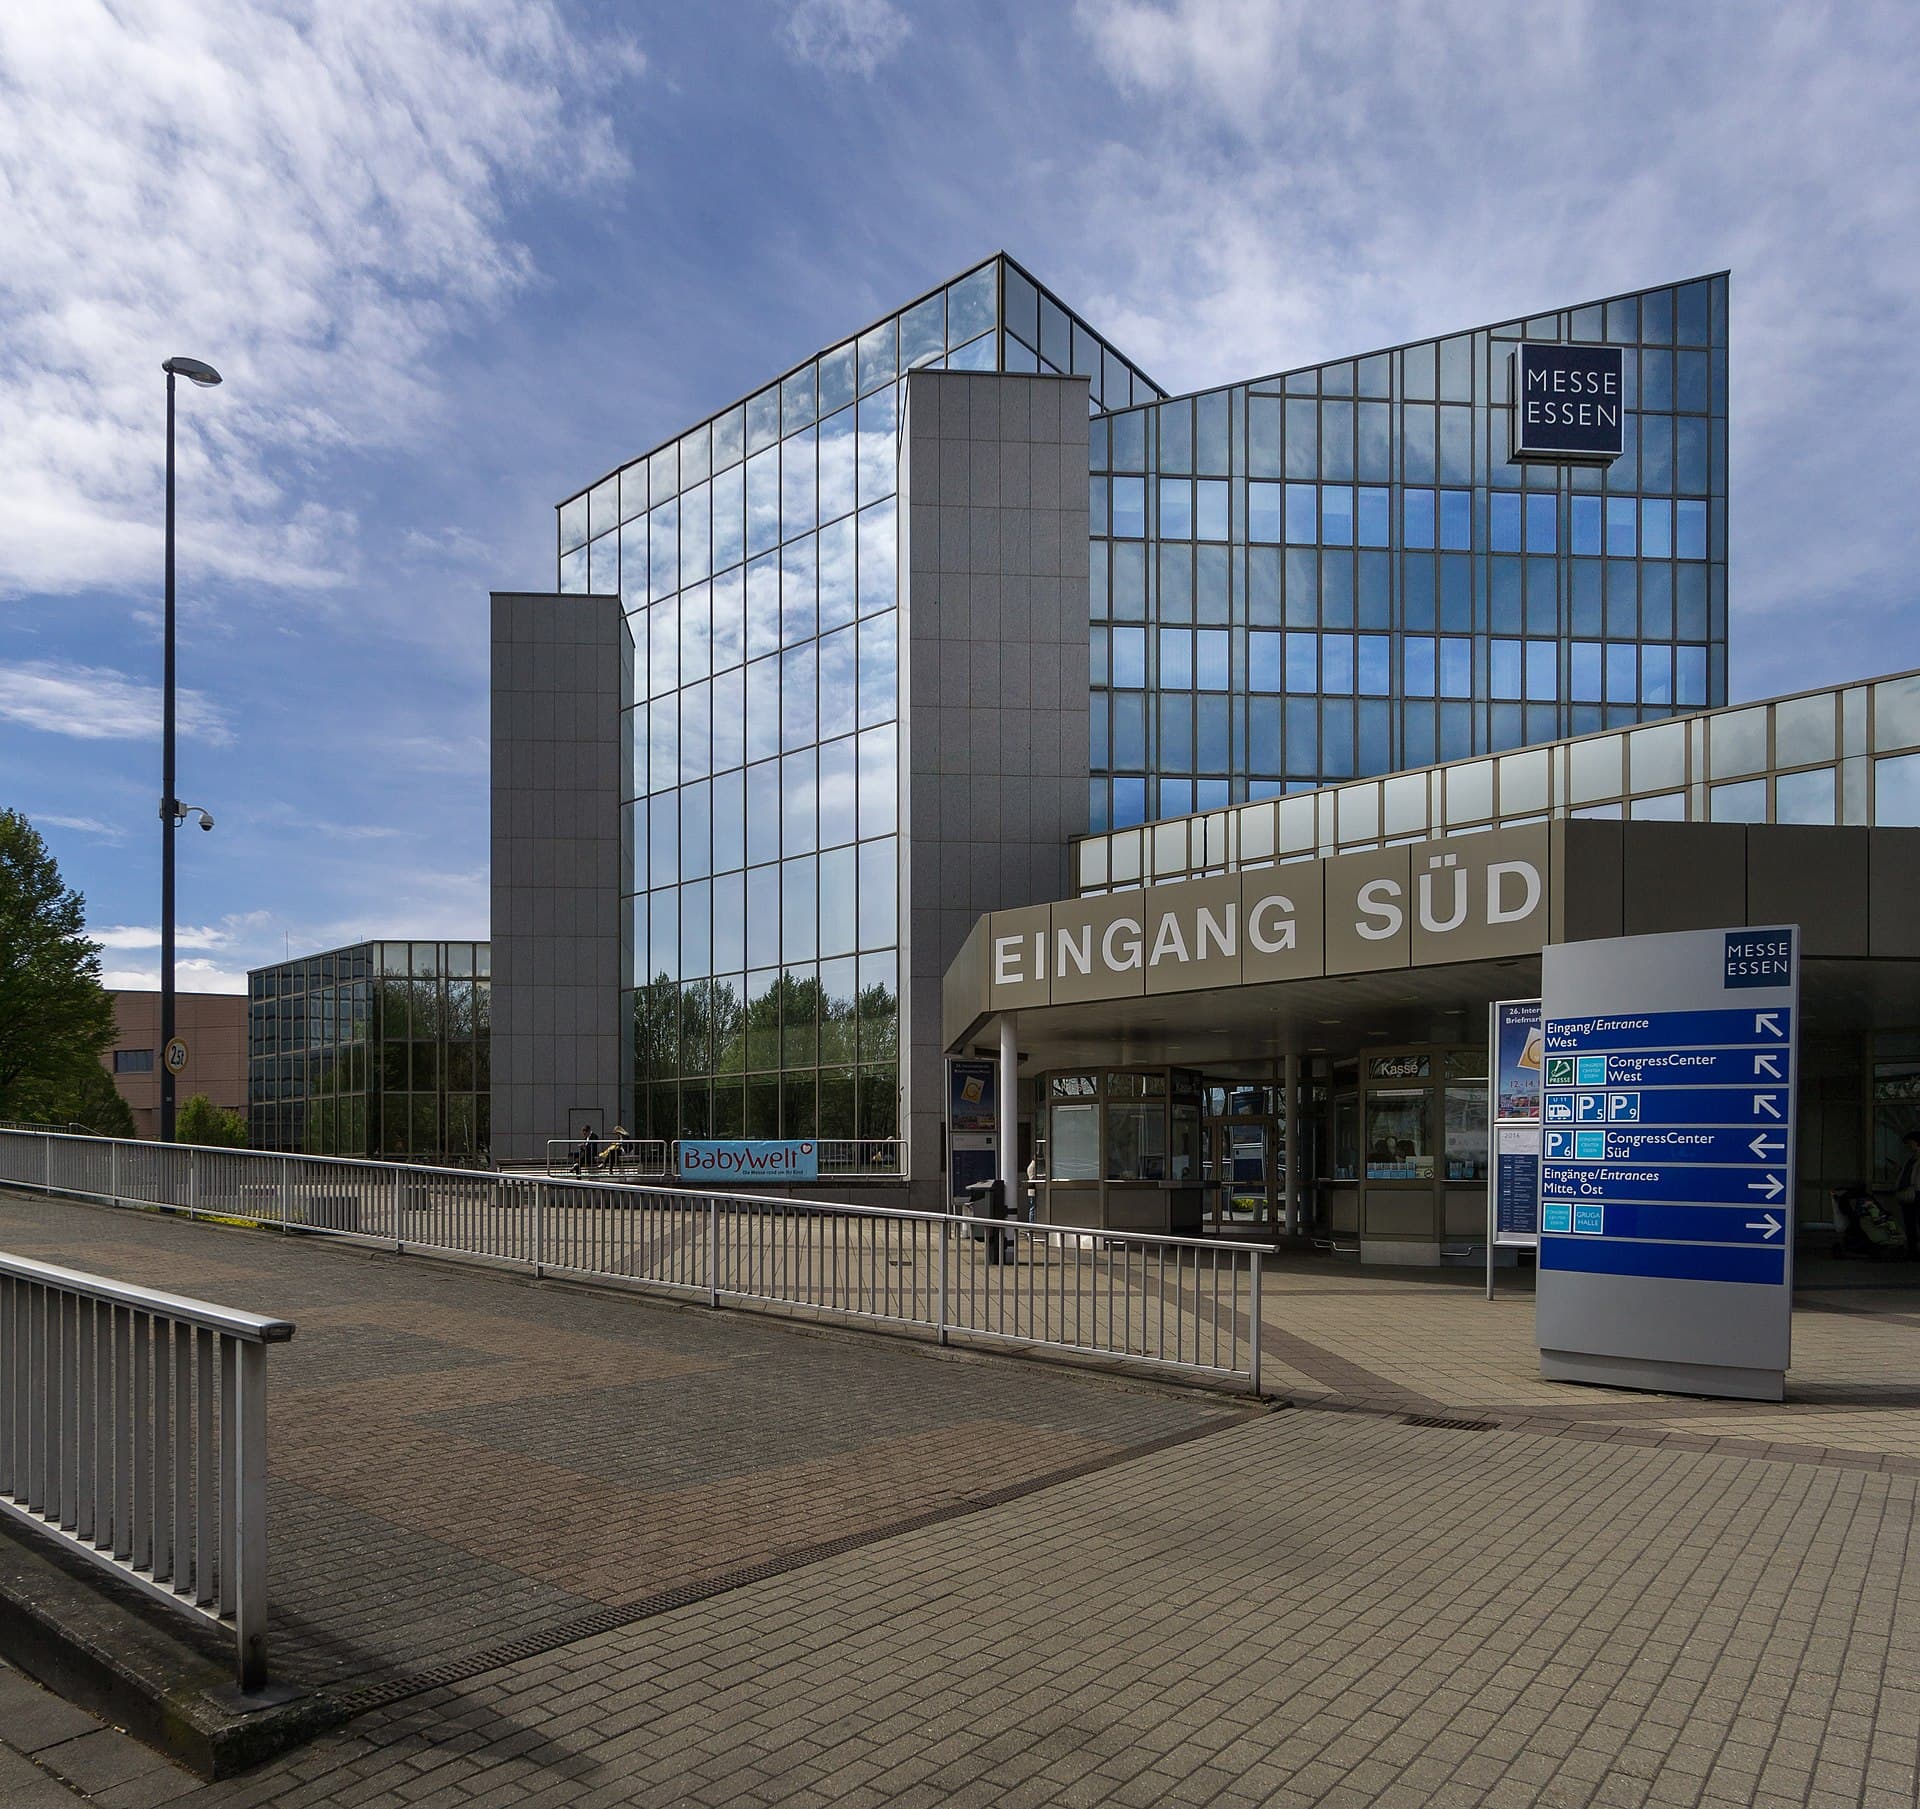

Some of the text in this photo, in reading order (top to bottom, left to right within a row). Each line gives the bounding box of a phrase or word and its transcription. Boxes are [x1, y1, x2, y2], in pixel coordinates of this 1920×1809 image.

[1528, 369, 1616, 394] MESSE
[1528, 402, 1616, 427] ESSEN
[995, 852, 1542, 985] EINGANG SÜD
[1728, 943, 1788, 958] MESSE
[1728, 960, 1787, 975] ESSEN
[1506, 1016, 1542, 1024] Briefmar
[1547, 1037, 1577, 1047] West
[1381, 1062, 1418, 1075] Kasse
[1609, 1054, 1717, 1070] CongressCenter
[1609, 1071, 1642, 1082] West
[1607, 1132, 1715, 1147] CongressCenter
[1607, 1147, 1630, 1158] Süd
[1544, 1183, 1603, 1196] Mitte, Ost
